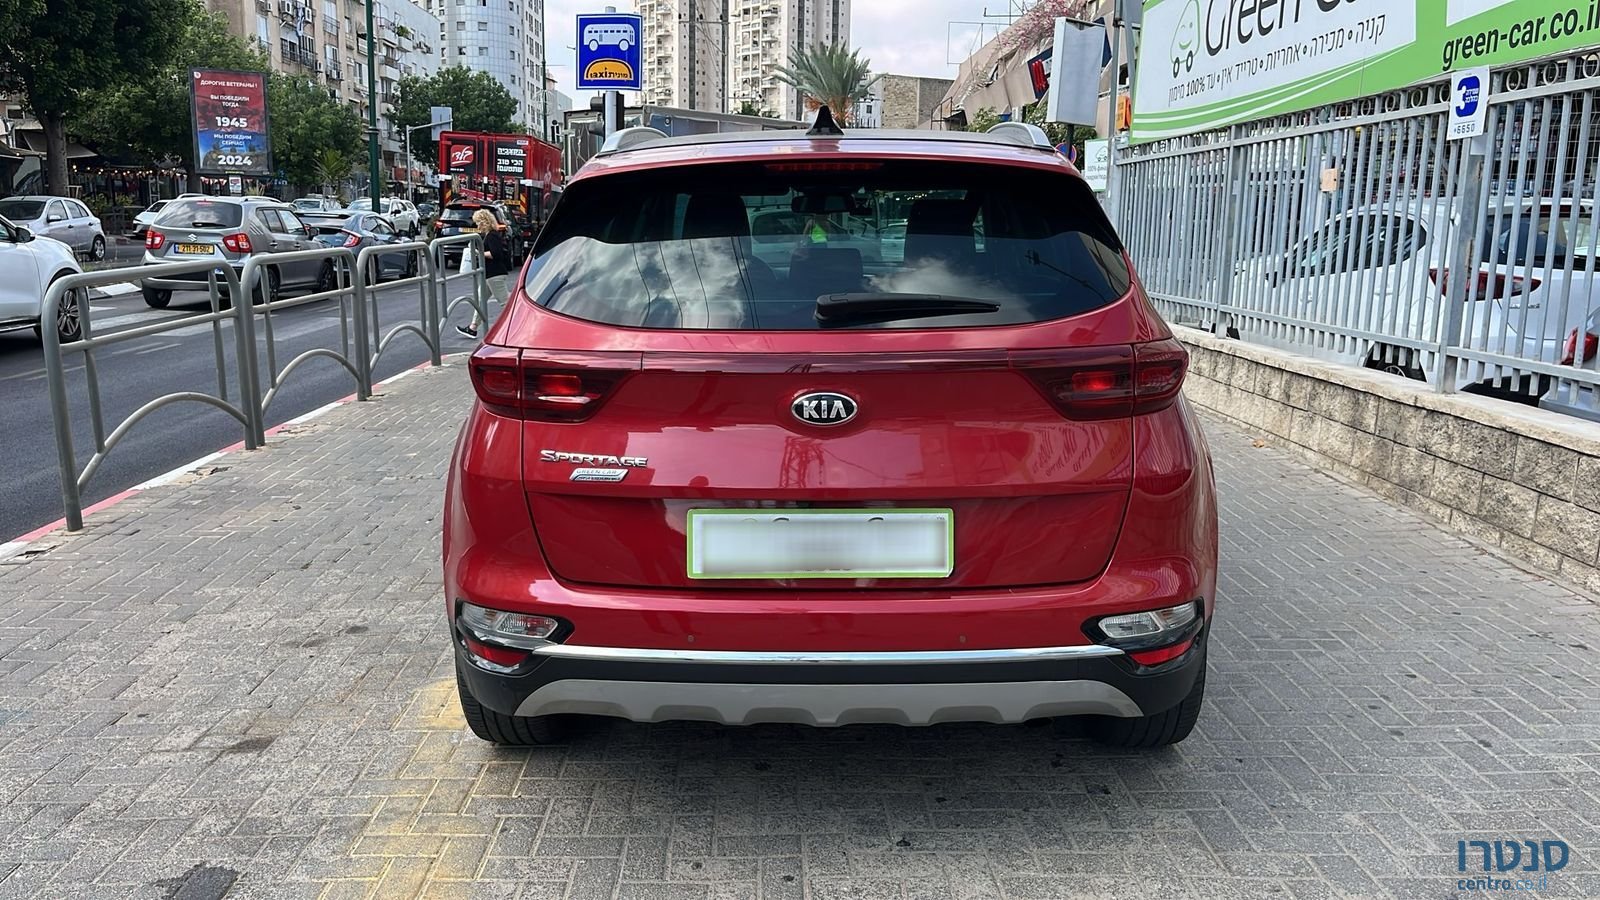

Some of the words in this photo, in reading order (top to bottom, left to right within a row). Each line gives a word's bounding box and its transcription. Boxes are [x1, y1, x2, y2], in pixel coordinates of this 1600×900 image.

[1355, 14, 1386, 45] קניה
[1309, 28, 1344, 58] מכירה
[1264, 42, 1301, 72] אחריות
[1220, 65, 1233, 91] אין
[1235, 57, 1258, 81] טרייד
[1186, 76, 1205, 97] 100%
[216, 116, 248, 128] 1945
[218, 155, 252, 166] 2024
[802, 400, 847, 418] KIA
[540, 449, 649, 467] SPORTAGE
